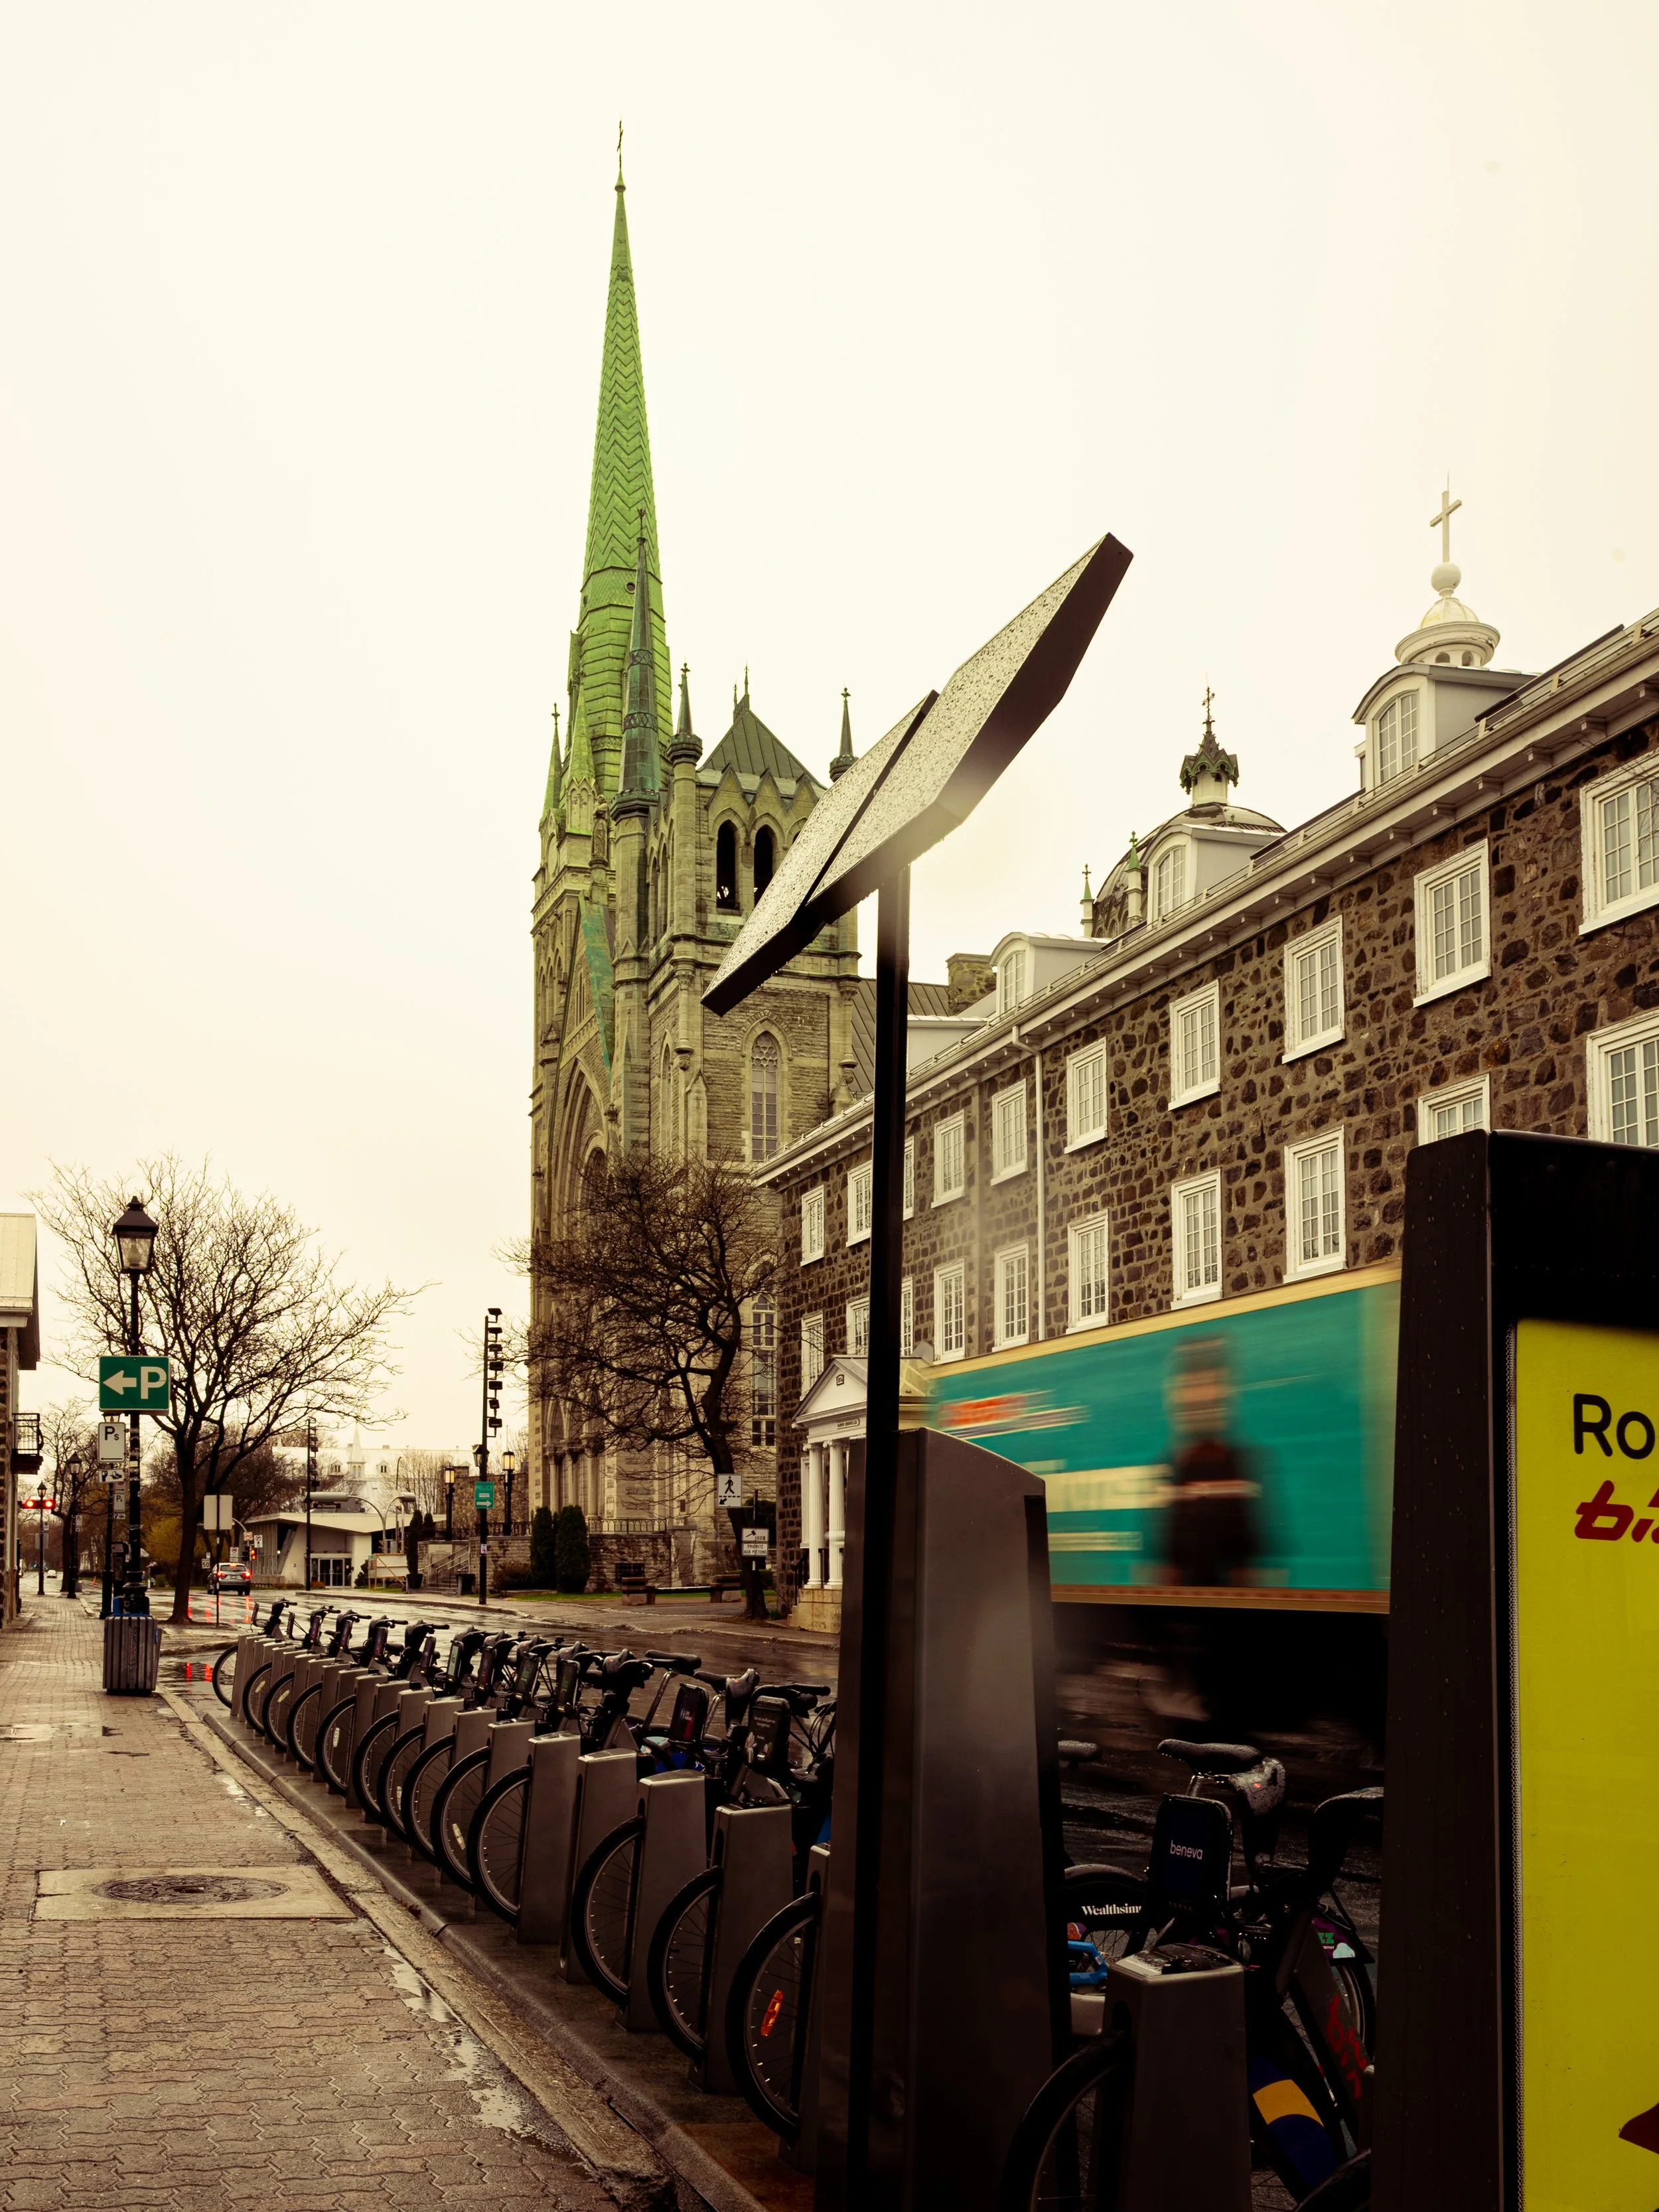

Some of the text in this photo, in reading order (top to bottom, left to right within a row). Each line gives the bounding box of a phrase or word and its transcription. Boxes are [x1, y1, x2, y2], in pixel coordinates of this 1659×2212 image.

[140, 1366, 167, 1400] P
[1573, 1393, 1656, 1459] Ro
[1169, 1839, 1204, 1860] beneva
